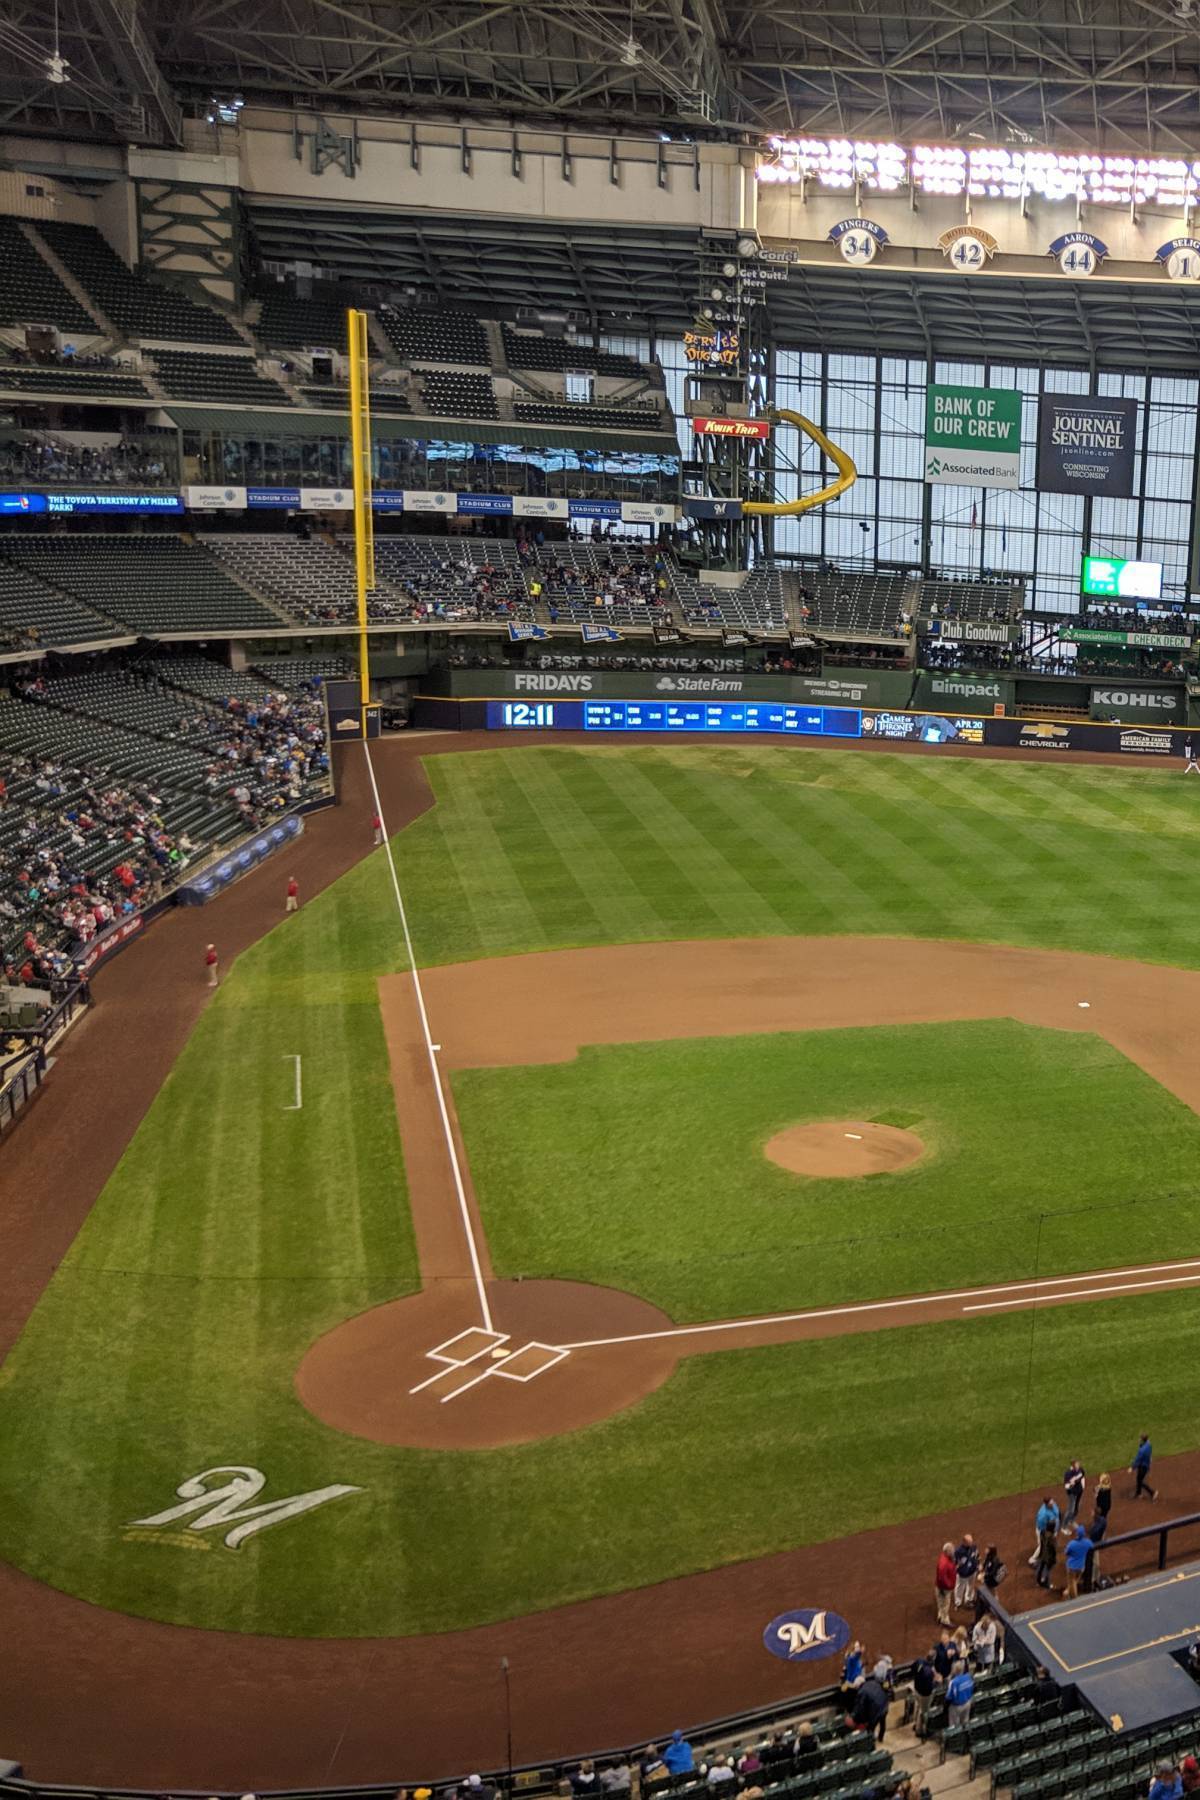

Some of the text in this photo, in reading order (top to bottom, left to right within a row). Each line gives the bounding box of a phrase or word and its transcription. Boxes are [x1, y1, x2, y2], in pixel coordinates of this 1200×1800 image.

[839, 219, 879, 233] FINGERS
[946, 227, 990, 242] ROBINSON
[1064, 233, 1095, 245] AARON
[845, 236, 872, 257] 34
[1172, 240, 1200, 249] SELIG
[758, 250, 799, 262] Gone!
[954, 244, 982, 264] 42
[1064, 250, 1092, 271] 44
[1180, 257, 1191, 278] 1
[740, 270, 788, 280] Get Outta
[743, 279, 766, 287] Here
[725, 295, 756, 306] Get Up
[714, 313, 745, 323] Get Up
[935, 396, 996, 417] BANK OF
[933, 416, 966, 435] OUR
[1052, 416, 1124, 434] JOURNAL
[1051, 431, 1124, 449] SENTINEL
[1061, 447, 1115, 456] jsonline.com
[1063, 463, 1109, 473] CONNECTING
[1066, 470, 1106, 479] WISCONSIN
[48, 496, 178, 506] THE TOYOTA TERRITORY AT MILLER
[459, 500, 491, 508] STADIUM
[570, 505, 600, 513] STADIUM
[941, 621, 1009, 641] Club Goodwill
[1134, 635, 1161, 645] CHECK
[1164, 637, 1185, 646] DECK
[515, 674, 592, 691] FRIDAYS
[945, 679, 1000, 697] impact
[1093, 690, 1177, 709] KOHL'S
[504, 703, 553, 726] 12:11
[880, 713, 905, 722] GAME
[878, 721, 914, 731] THRONES
[955, 719, 983, 729] APR 20
[1019, 739, 1070, 749] CHEVROLET
